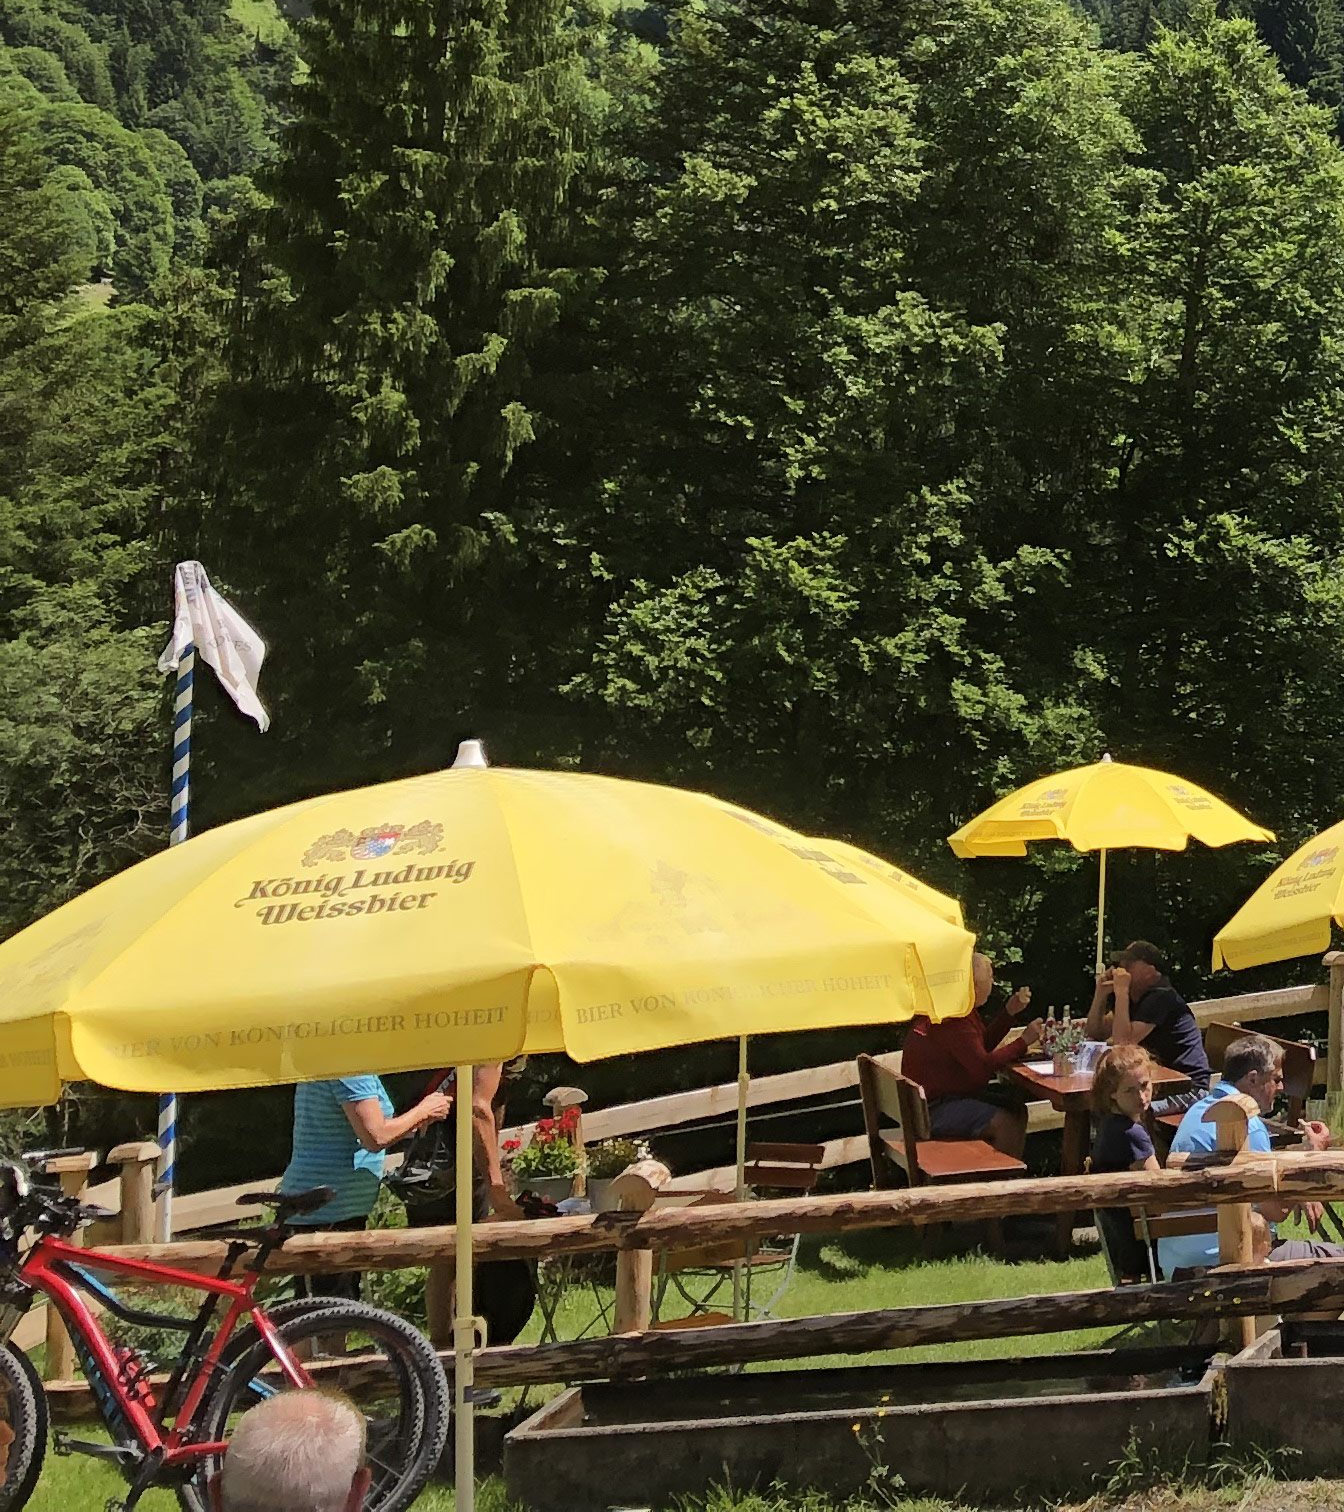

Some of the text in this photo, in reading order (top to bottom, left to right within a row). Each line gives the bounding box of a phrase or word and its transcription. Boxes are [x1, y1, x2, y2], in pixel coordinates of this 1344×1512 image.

[234, 859, 476, 908] König Ludwig
[256, 892, 438, 925] Weissbier
[575, 1001, 624, 1025] BIER
[629, 994, 677, 1015] VON
[109, 1039, 163, 1060] IER
[171, 1031, 223, 1052] VON
[414, 1005, 509, 1030] HOHEIT
